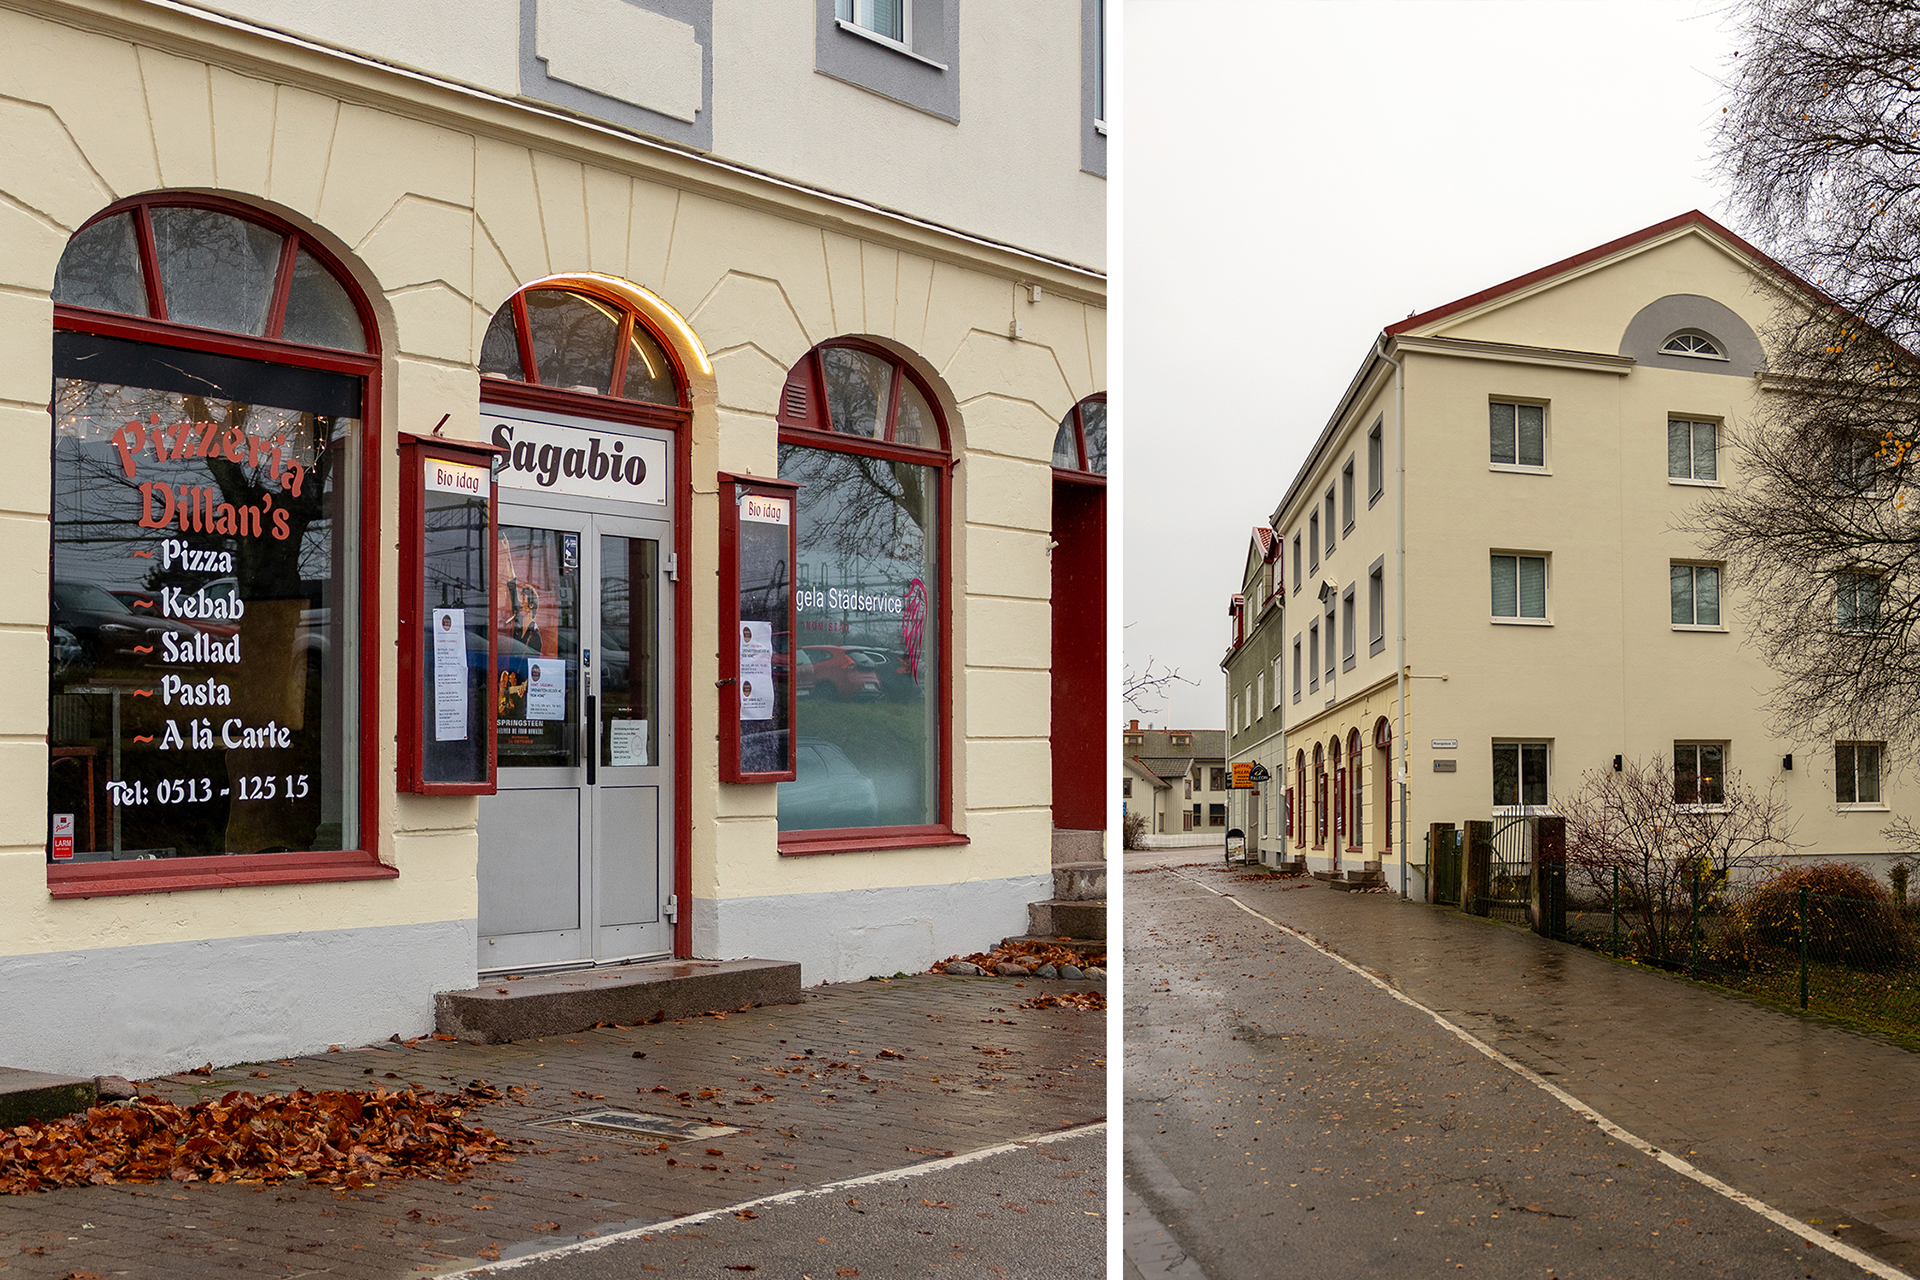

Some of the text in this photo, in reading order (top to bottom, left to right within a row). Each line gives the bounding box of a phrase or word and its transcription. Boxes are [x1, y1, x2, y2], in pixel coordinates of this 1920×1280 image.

[491, 424, 647, 487] Sagabio
[437, 468, 479, 493] Bio idag
[138, 481, 290, 540] Dillan's
[748, 501, 781, 522] Bio idag
[161, 538, 233, 573] Pizza
[160, 586, 245, 620] Kebab
[829, 587, 902, 614] Städservice
[161, 631, 241, 664] Sallad
[161, 674, 231, 706] Pasta
[159, 719, 184, 750] A
[221, 718, 291, 750] Carte
[106, 779, 149, 806] Tel:
[156, 777, 213, 804] 0513
[238, 775, 277, 801] 125
[285, 774, 309, 799] 15
[55, 839, 72, 847] LARM
